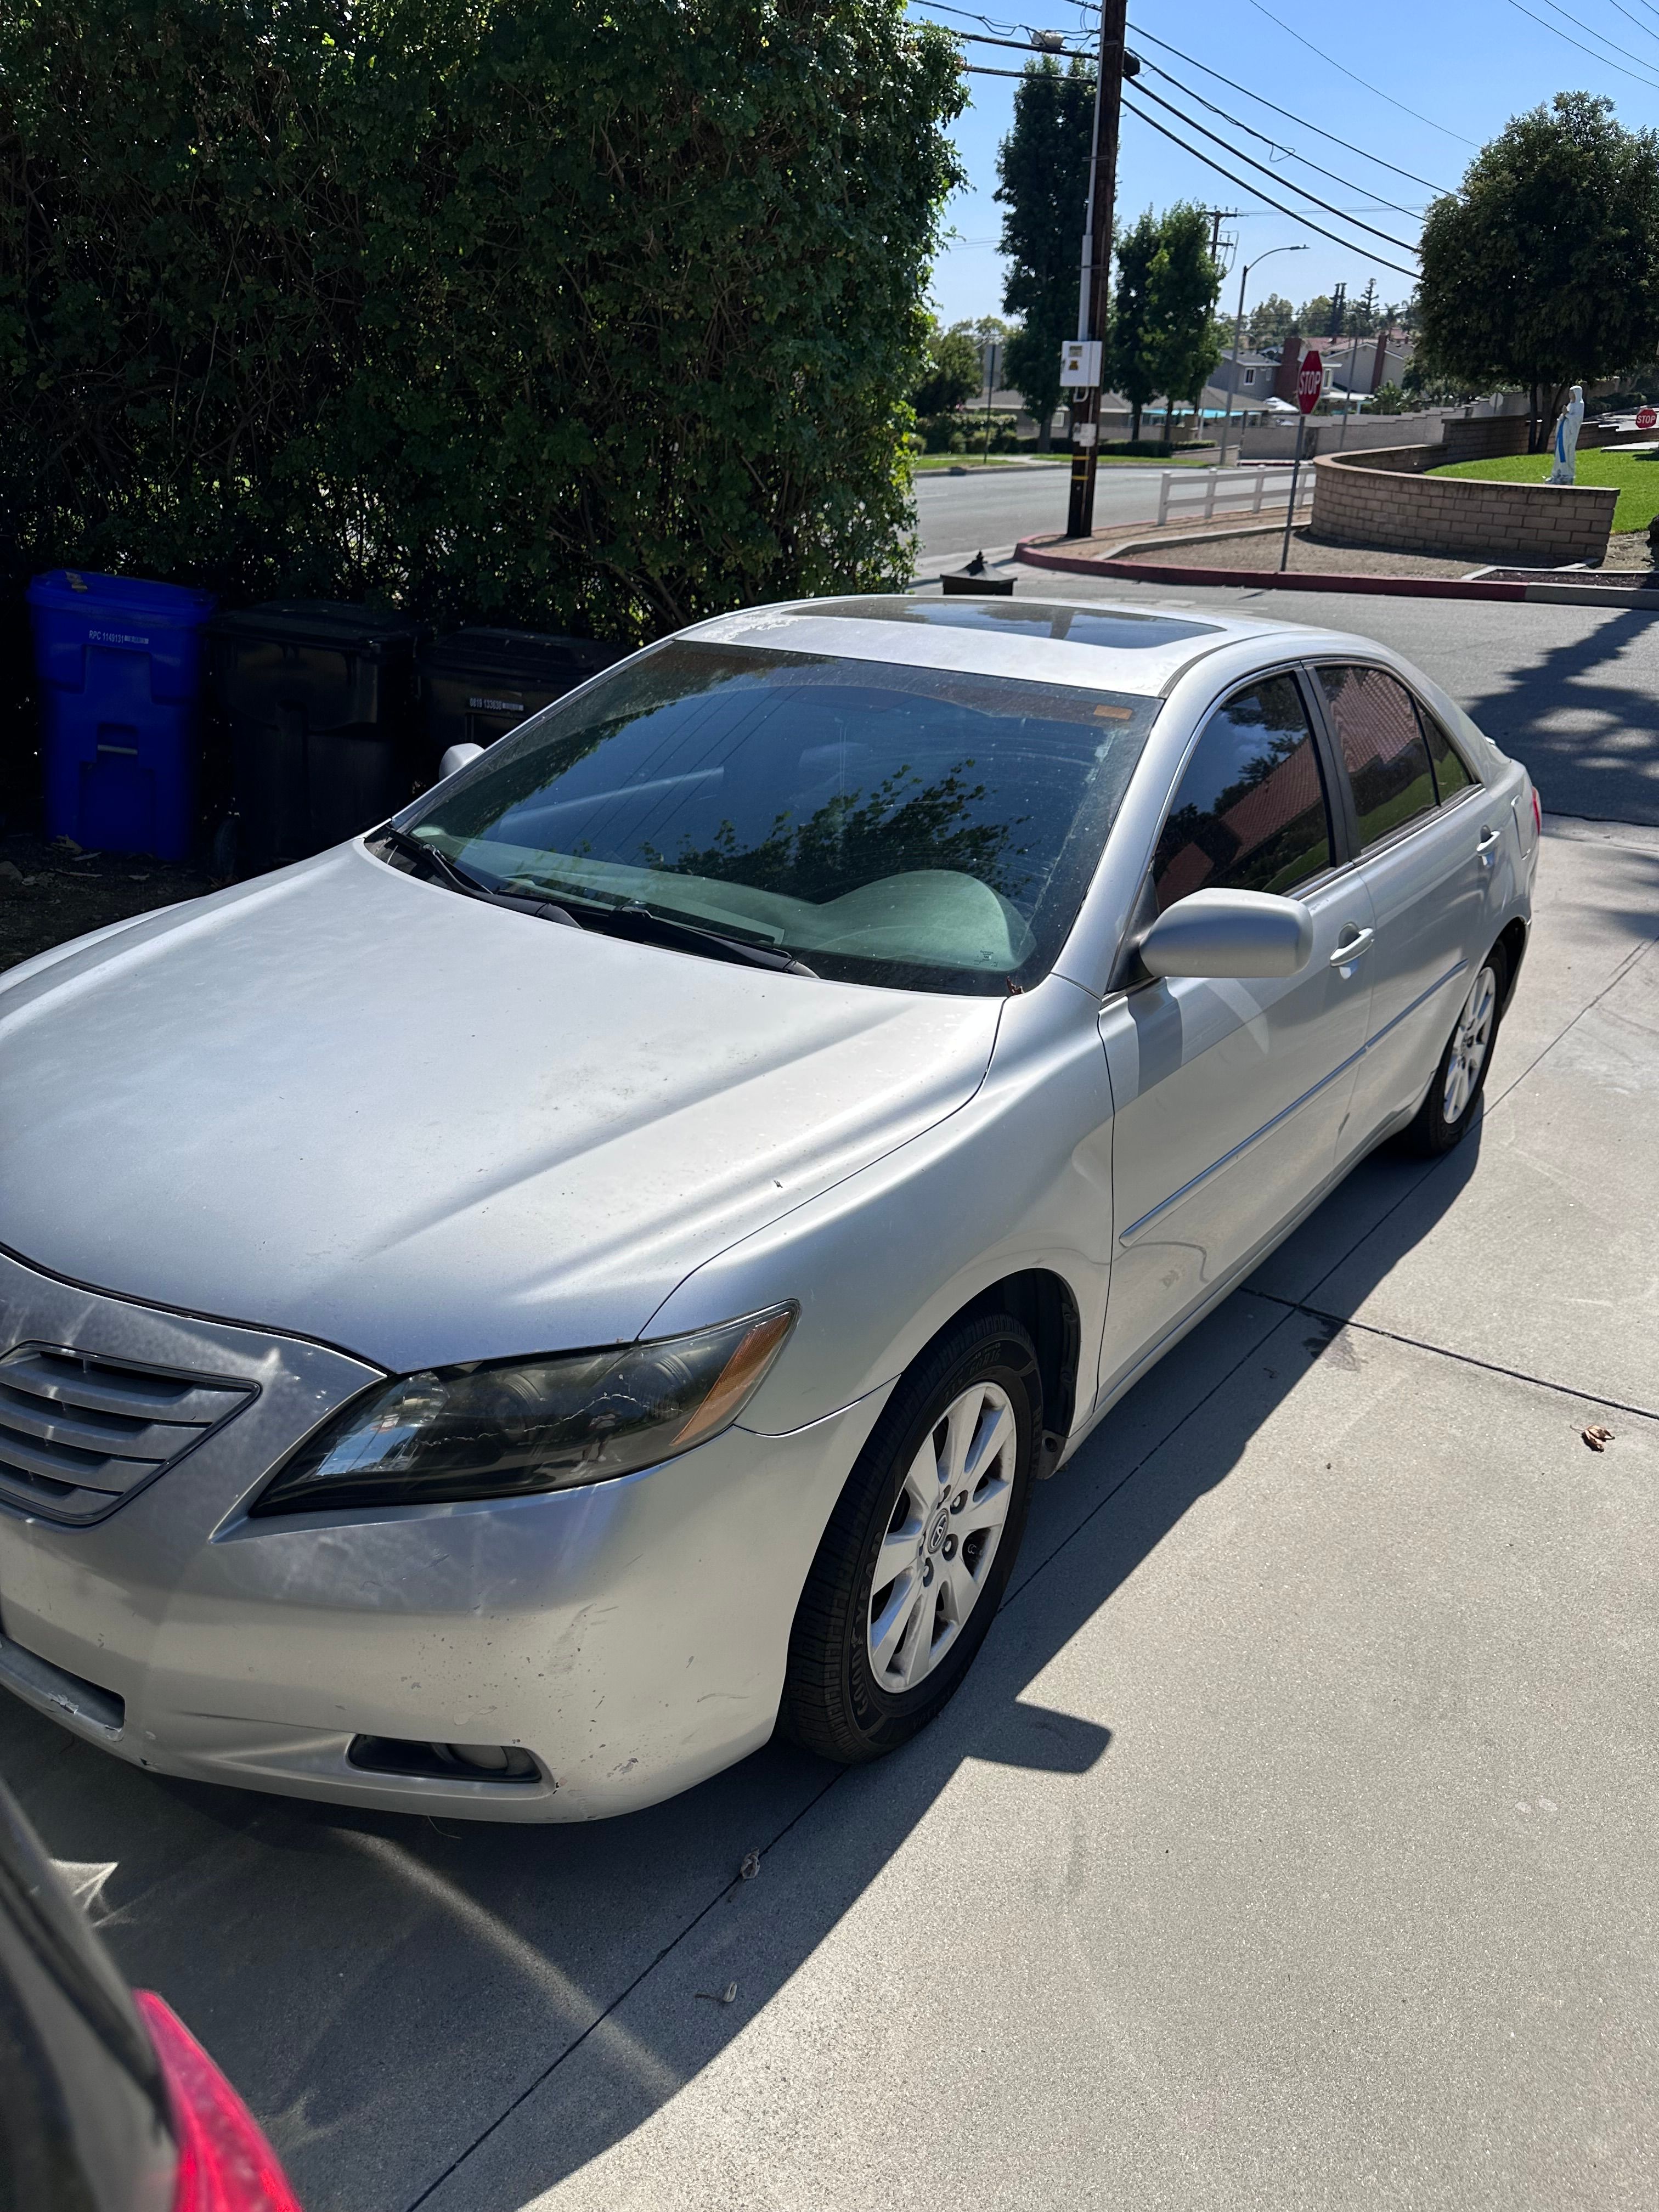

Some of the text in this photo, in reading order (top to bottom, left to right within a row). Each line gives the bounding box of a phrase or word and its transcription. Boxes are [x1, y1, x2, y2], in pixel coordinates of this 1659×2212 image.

[1299, 371, 1321, 395] STOP
[1637, 415, 1656, 424] STOP
[89, 630, 101, 640] RPC
